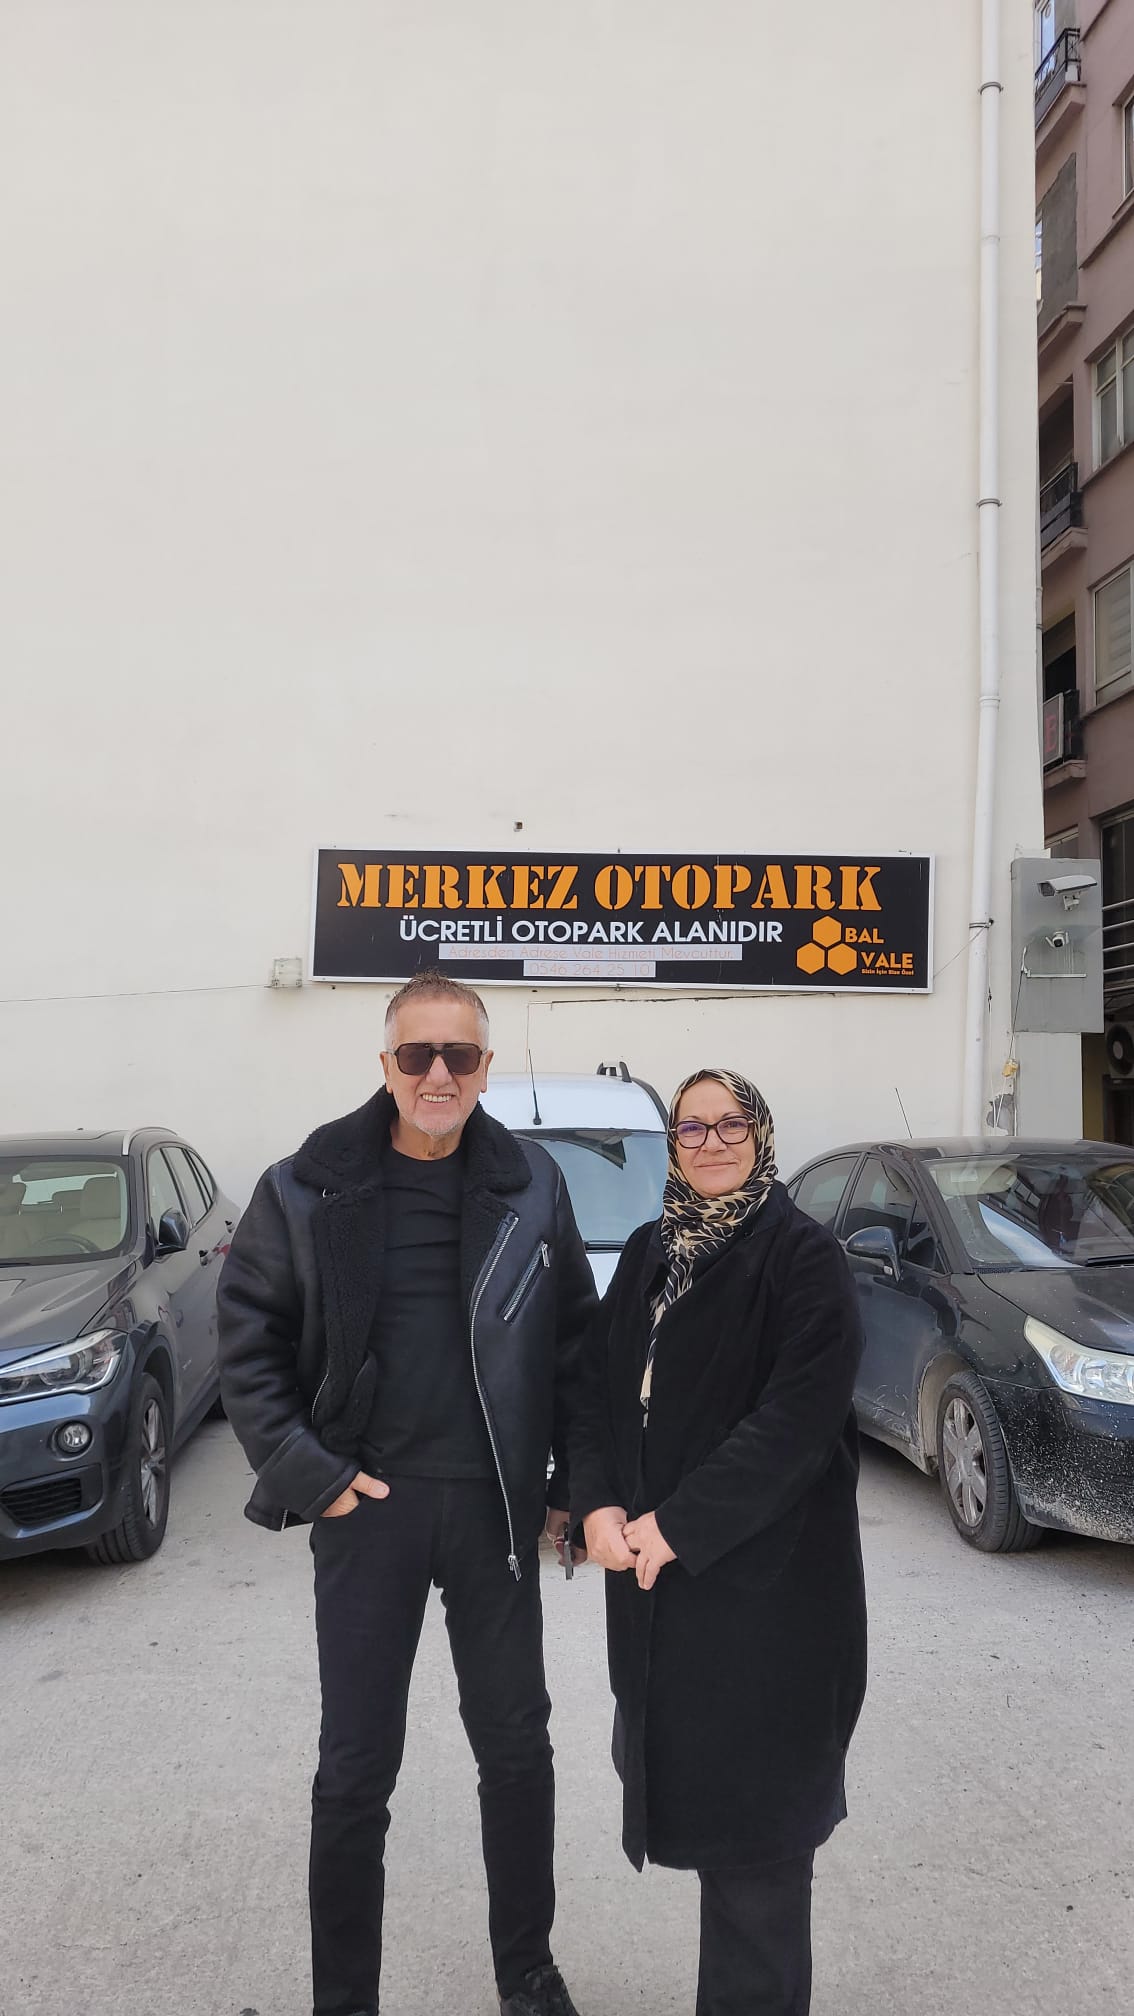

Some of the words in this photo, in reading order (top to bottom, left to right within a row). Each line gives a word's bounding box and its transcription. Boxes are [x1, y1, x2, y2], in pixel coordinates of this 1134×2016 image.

[336, 863, 579, 910] MERKEZ
[594, 863, 883, 911] OTOPARK
[399, 914, 503, 942] ÜCRETLİ
[511, 919, 645, 943] OTOPARK
[651, 920, 784, 943] ALANIDIR
[844, 926, 885, 944] BAL
[448, 945, 514, 958] Adresden
[519, 945, 568, 959] Adrese
[573, 946, 602, 959] Vale
[860, 951, 914, 969] VALE
